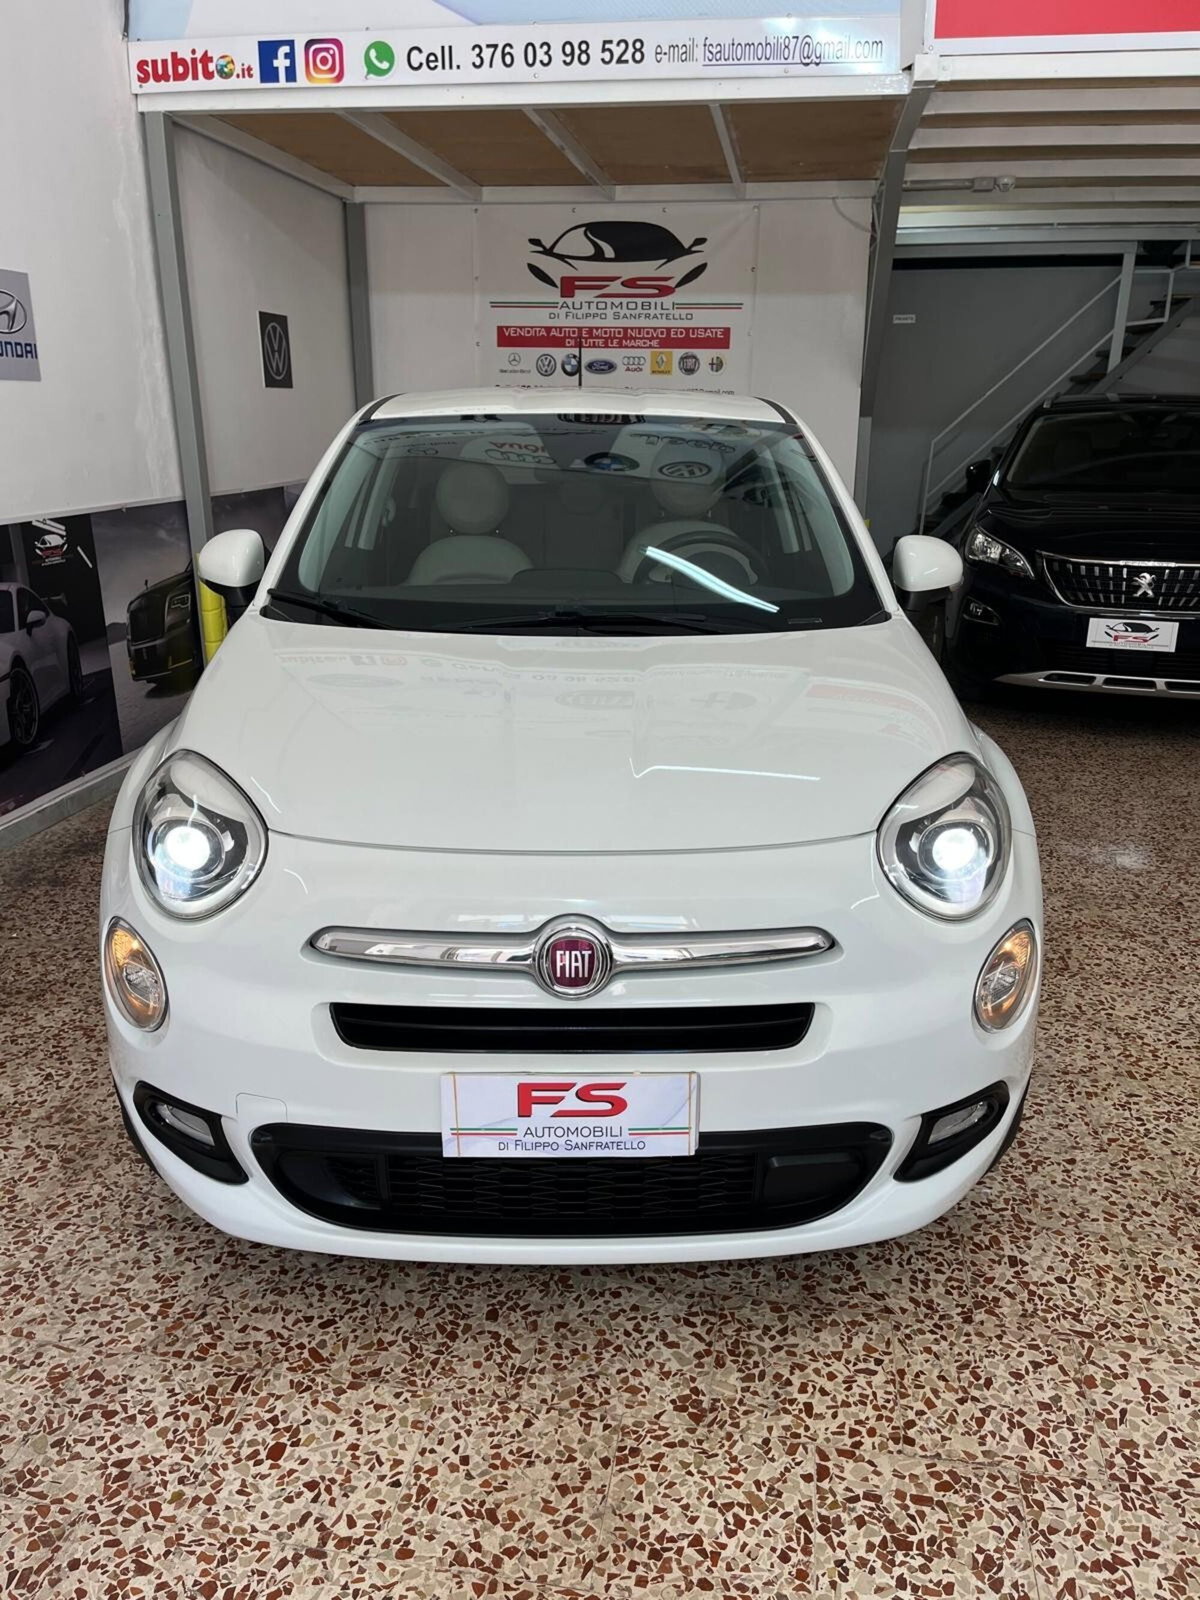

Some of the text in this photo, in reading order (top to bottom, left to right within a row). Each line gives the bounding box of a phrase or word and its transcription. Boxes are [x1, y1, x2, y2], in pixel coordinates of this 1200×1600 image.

[406, 35, 883, 71] Cell. 376 03 98 528 e-mail: fsautomobili87@gmail.com
[136, 48, 254, 84] subito.it
[560, 276, 676, 298] FS
[559, 301, 676, 311] AUTOMOBILI
[548, 311, 694, 321] DI FILIPPO SANFRATELLO
[503, 327, 725, 338] VENDITA AUTO E MOTO NUOVO ED USATE
[565, 339, 575, 347] DI
[622, 340, 660, 348] MARCHE
[556, 950, 592, 978] FIAT
[517, 1082, 628, 1118] FS
[523, 1126, 623, 1138] AUTOMOBILI
[498, 1139, 646, 1151] DI FILIPPO SANFRATELLO
